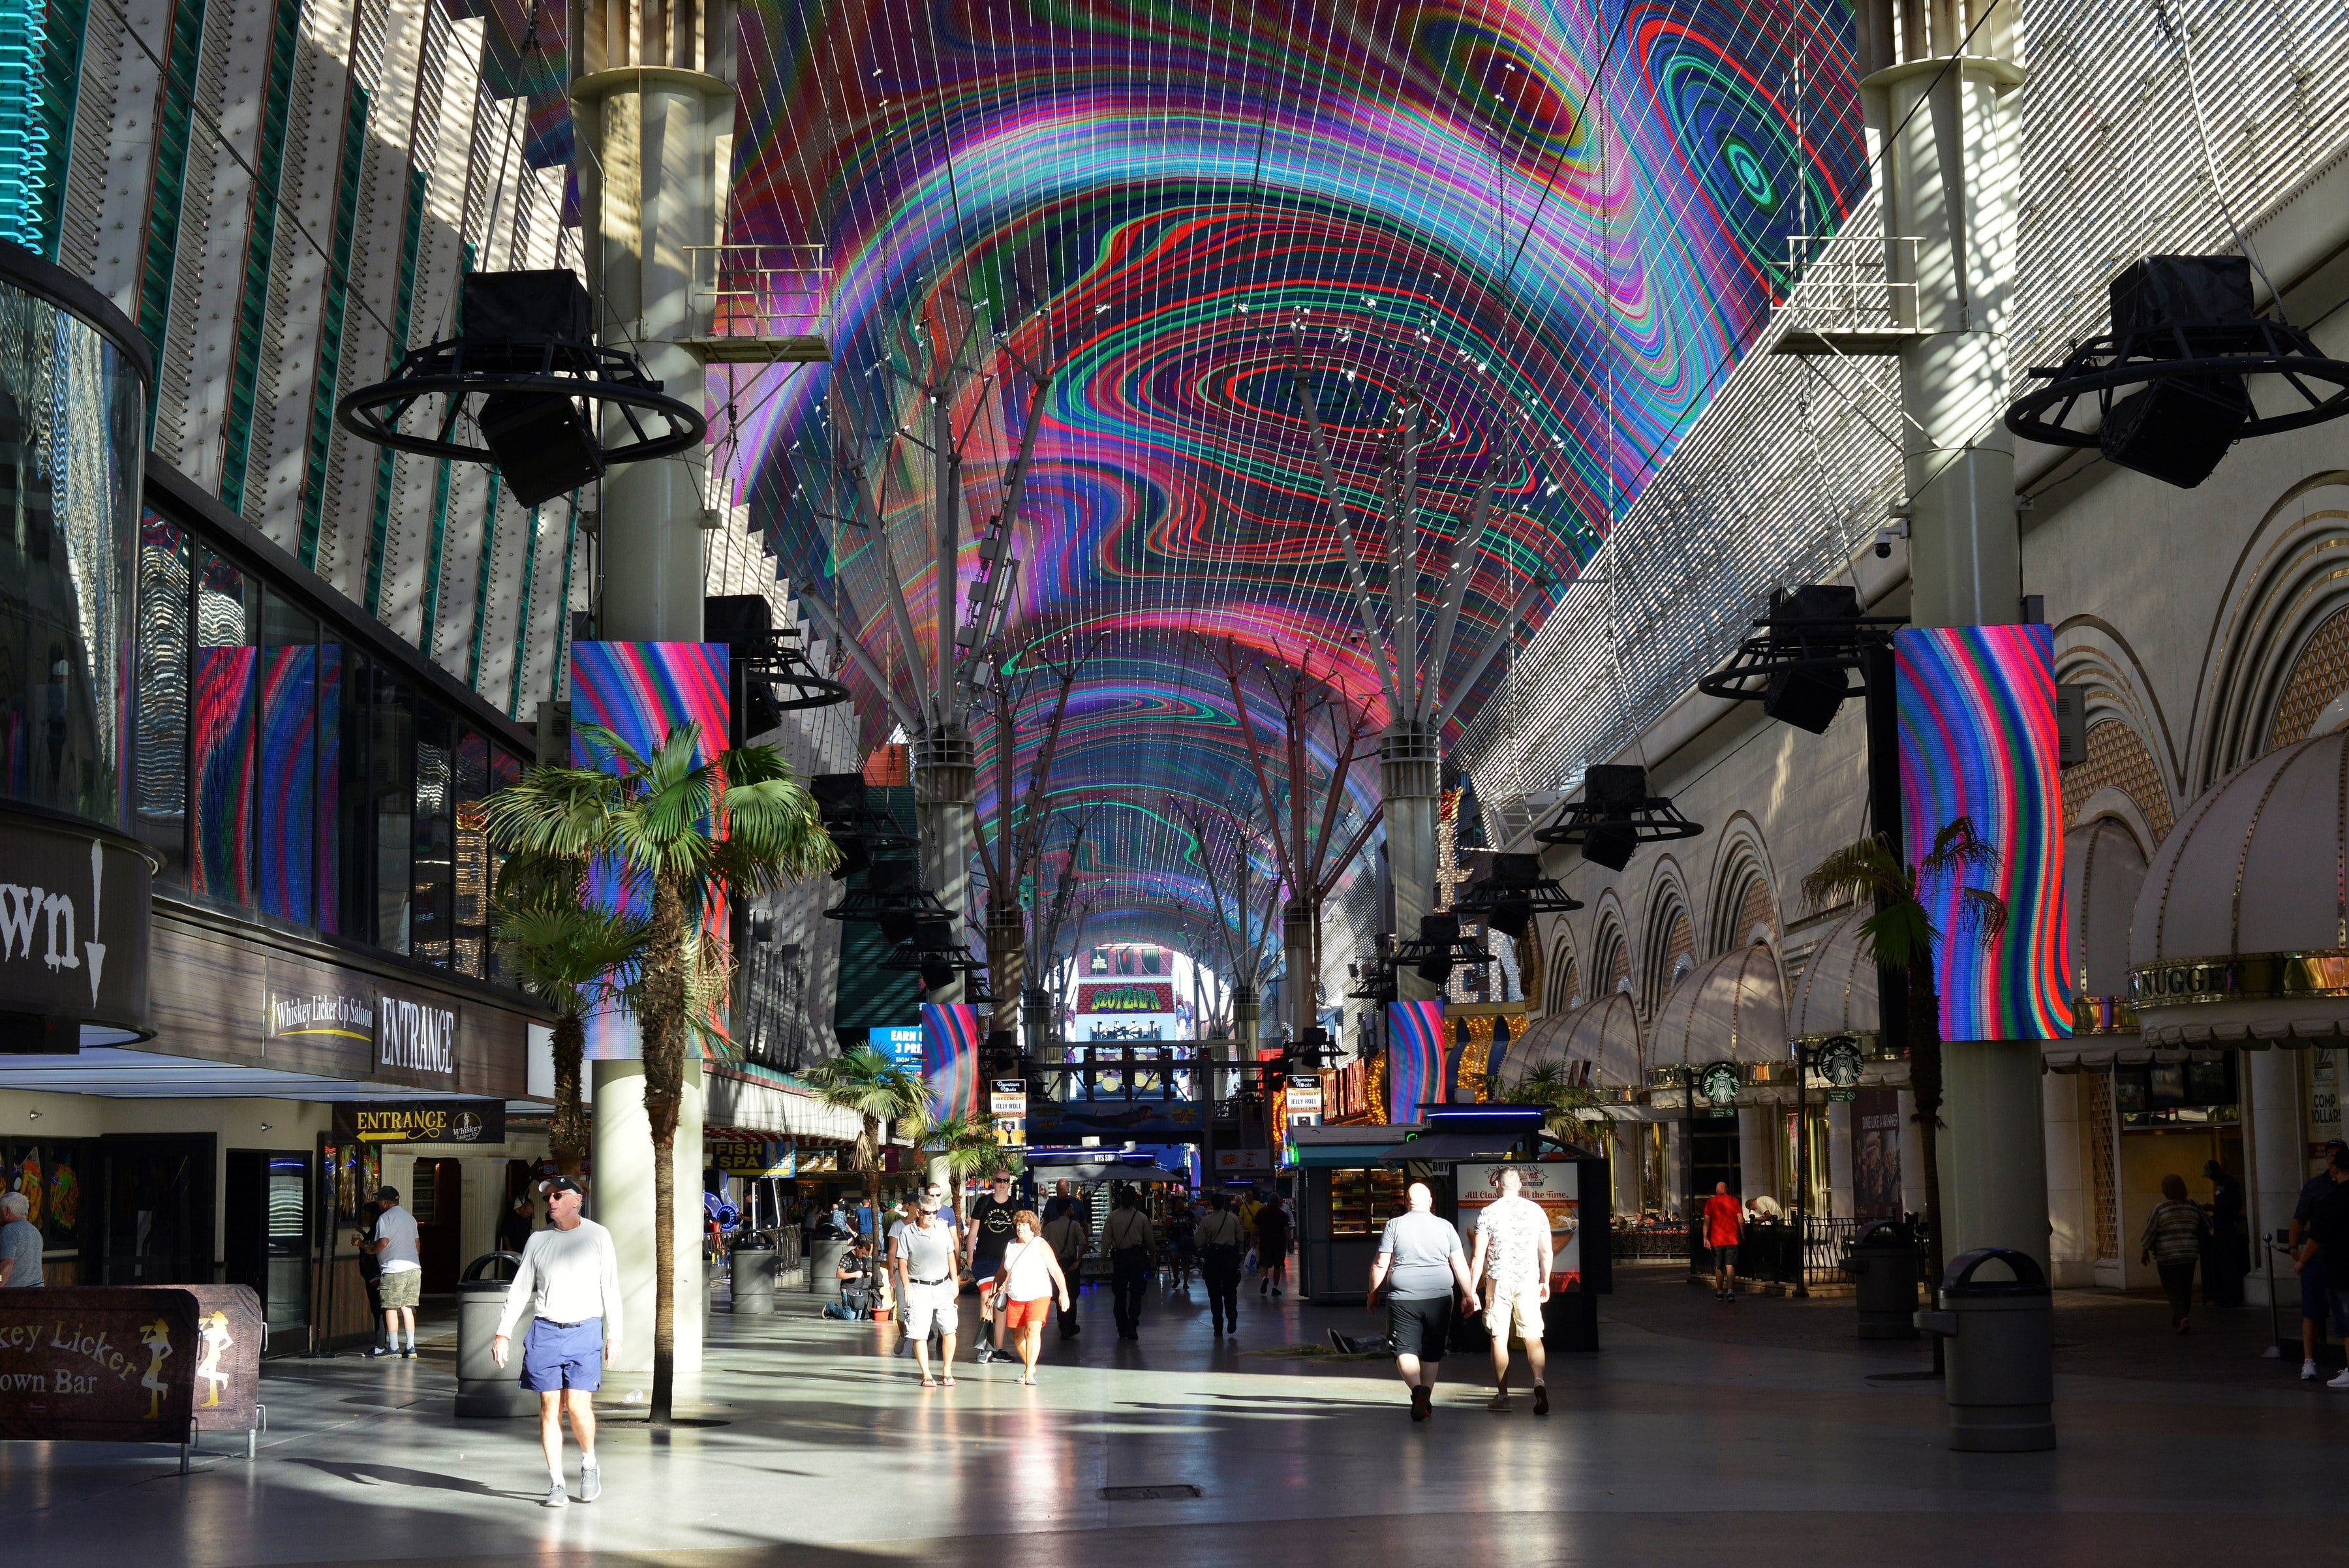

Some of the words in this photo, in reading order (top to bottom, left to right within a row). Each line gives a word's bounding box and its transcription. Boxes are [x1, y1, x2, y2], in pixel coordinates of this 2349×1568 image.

[2142, 964, 2245, 997] NUGGET
[277, 997, 311, 1029] Whiskey
[312, 995, 337, 1021] Licker
[338, 996, 348, 1028] Up
[350, 997, 373, 1028] Saloon
[381, 996, 453, 1074] ENTRANCE
[891, 1030, 917, 1042] EARN
[895, 1043, 902, 1054] 3
[904, 1043, 922, 1054] PRI
[2314, 1094, 2336, 1108] COMP
[357, 1111, 446, 1130] ENTRANCE
[1862, 1116, 1871, 1130] DINE
[1871, 1115, 1879, 1128] LIKE
[1882, 1113, 1899, 1128] WINNER
[453, 1125, 483, 1135] Whiskey
[716, 1143, 762, 1155] FISH
[719, 1156, 760, 1168] SPA
[1432, 1162, 1449, 1172] BUY
[1465, 1191, 1478, 1199] All
[1479, 1191, 1497, 1199] Clas
[1546, 1190, 1569, 1199] Time.
[50, 1319, 137, 1383] Licker
[54, 1368, 98, 1394] Bar
